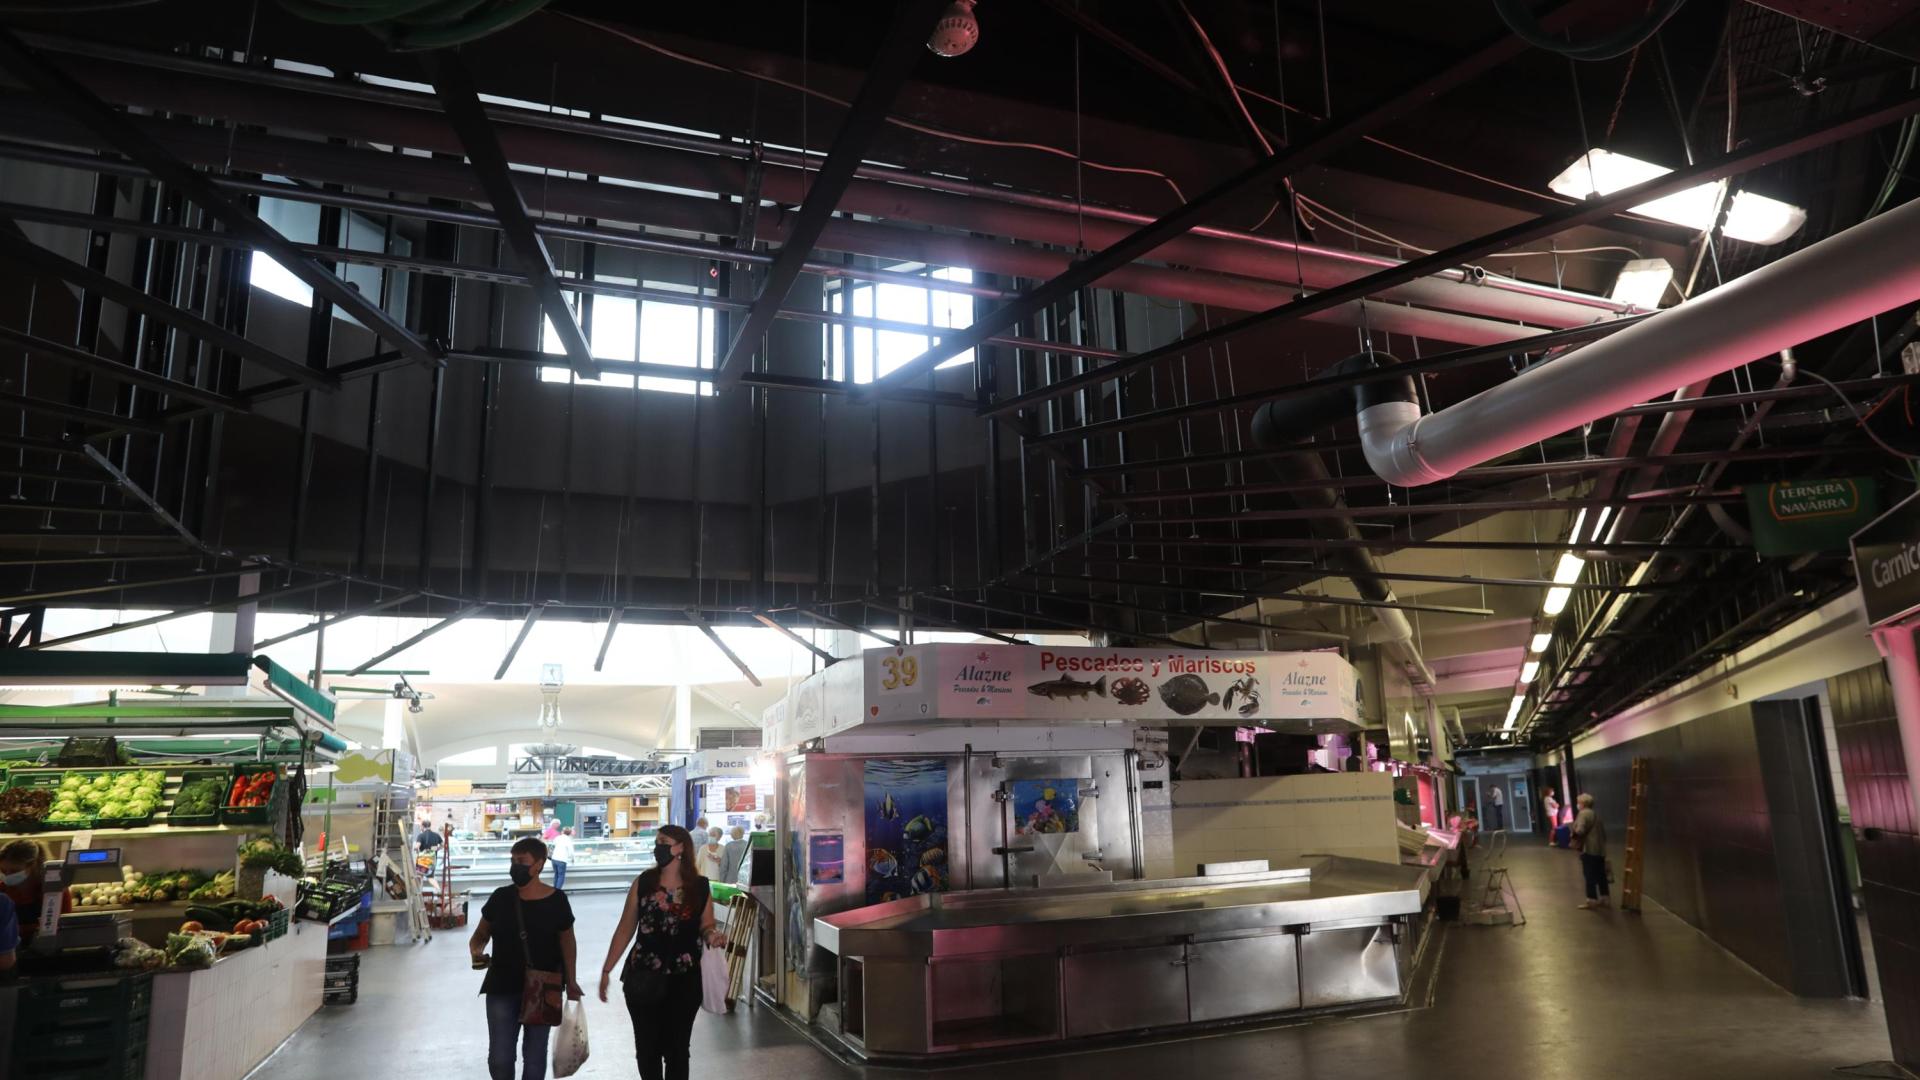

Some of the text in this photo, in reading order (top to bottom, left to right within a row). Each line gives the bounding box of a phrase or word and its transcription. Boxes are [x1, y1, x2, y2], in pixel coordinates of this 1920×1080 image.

[1780, 483, 1845, 499] TERNERA
[1781, 498, 1847, 513] NAVARRA
[1040, 651, 1256, 677] Pescados y Mariscos
[882, 655, 917, 690] 39
[955, 665, 1012, 682] Alazne
[1282, 671, 1327, 686] Alazne
